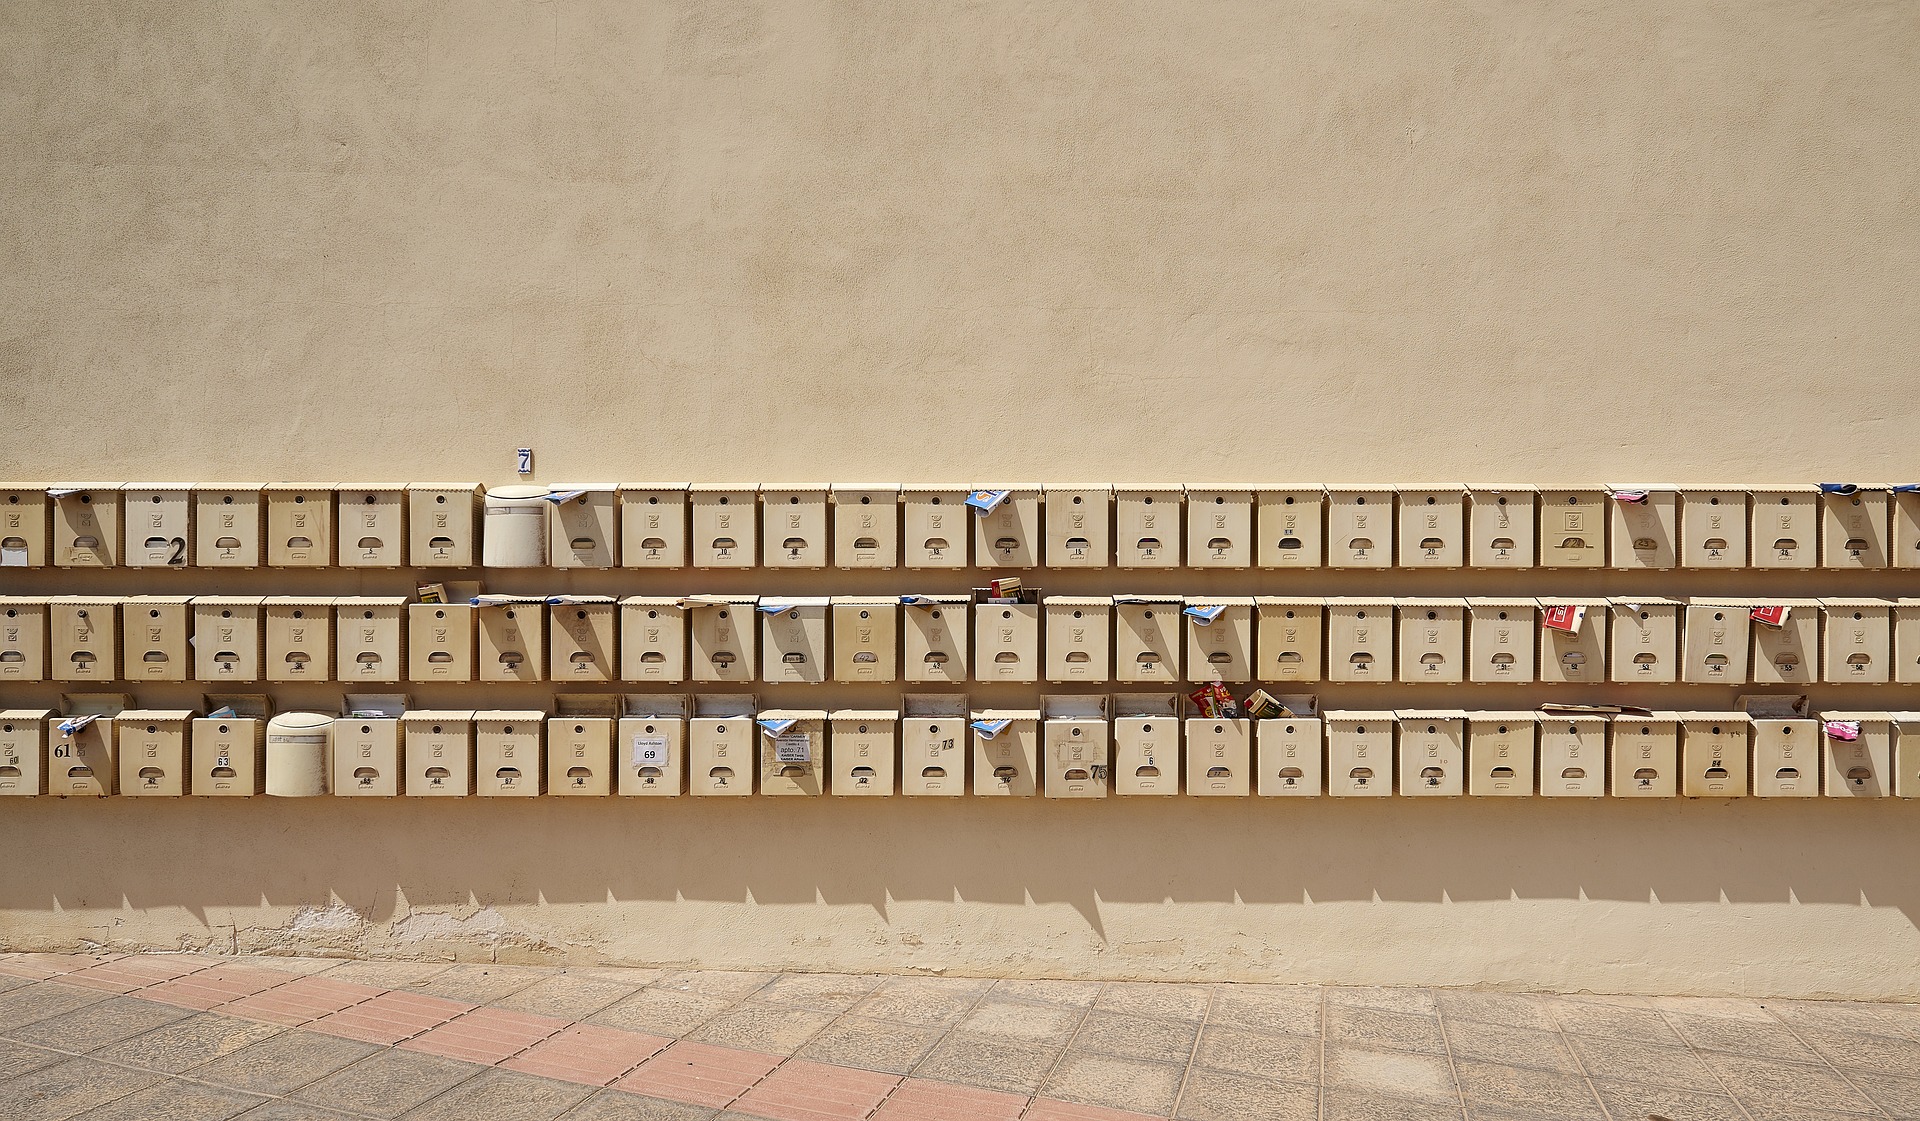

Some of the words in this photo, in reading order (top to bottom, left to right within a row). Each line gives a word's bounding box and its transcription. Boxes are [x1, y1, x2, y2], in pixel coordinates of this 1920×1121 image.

[518, 453, 529, 468] 7
[168, 537, 186, 564] 2
[54, 744, 71, 758] 61
[942, 739, 954, 751] 73
[10, 756, 19, 765] 60
[218, 758, 228, 766] 63
[1149, 757, 1154, 765] 6
[1090, 765, 1107, 779] 75
